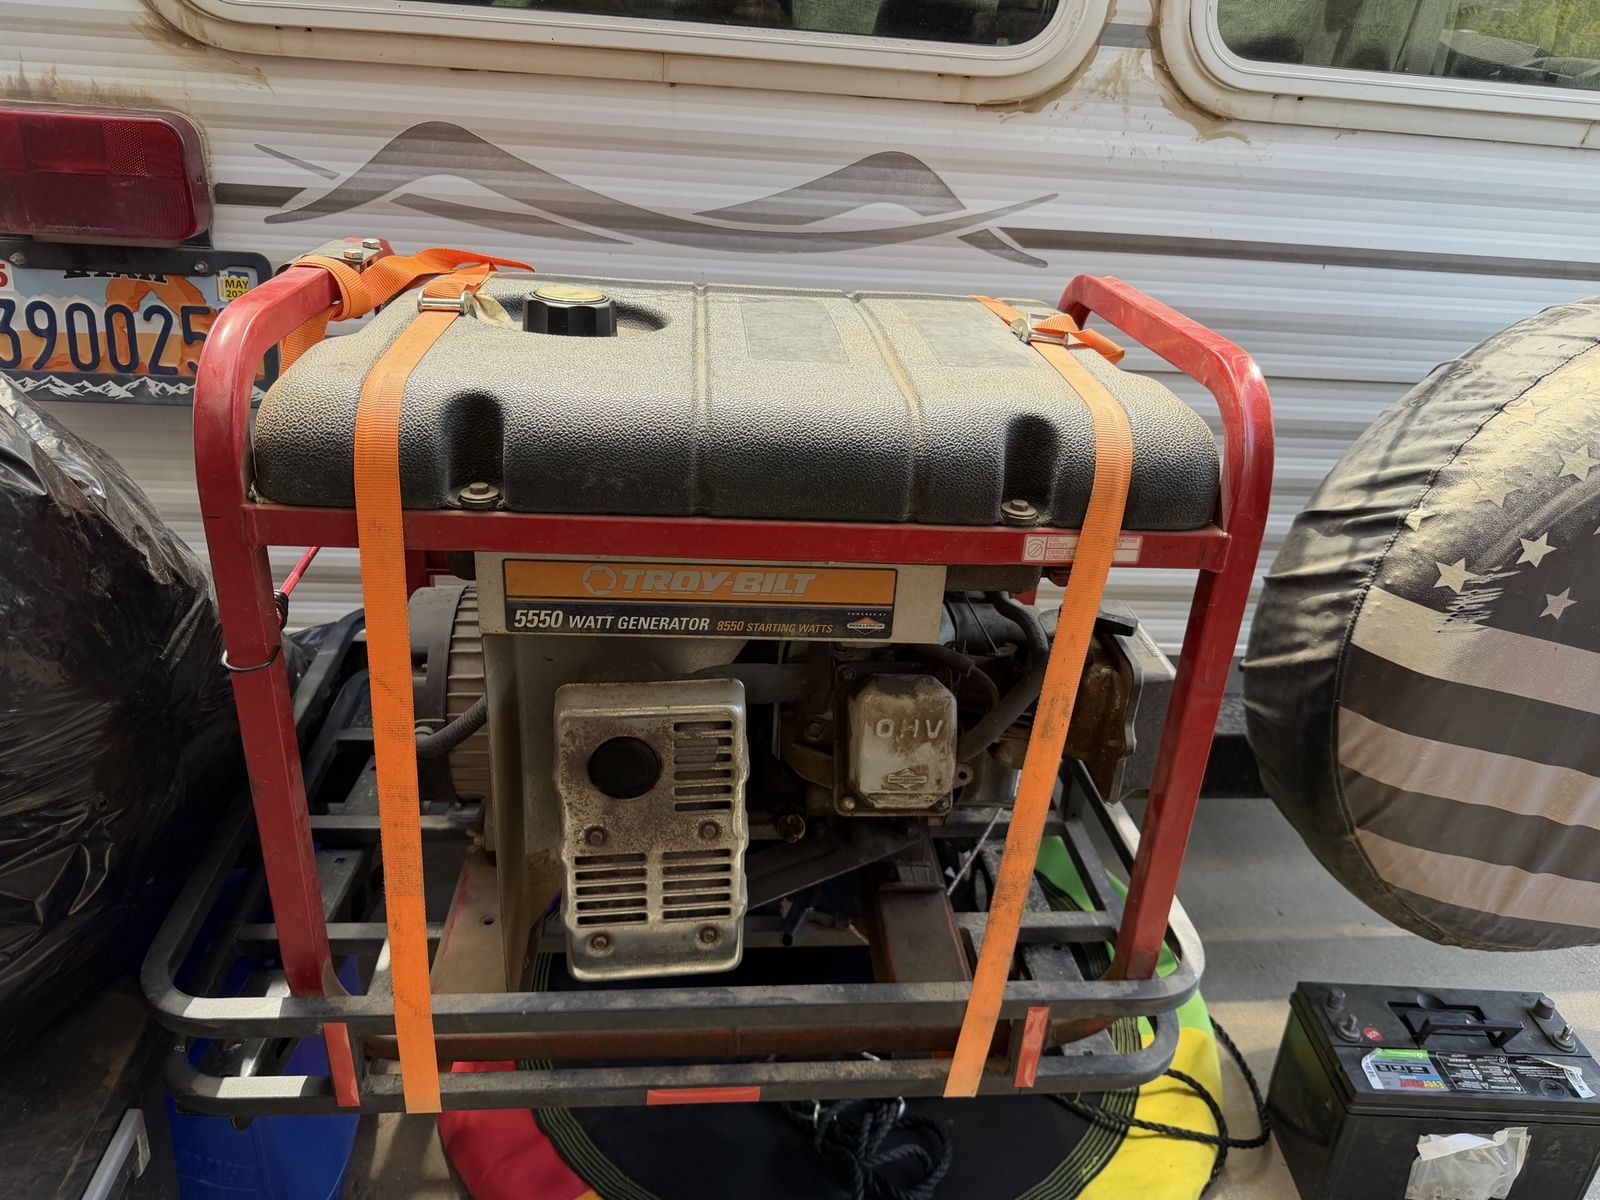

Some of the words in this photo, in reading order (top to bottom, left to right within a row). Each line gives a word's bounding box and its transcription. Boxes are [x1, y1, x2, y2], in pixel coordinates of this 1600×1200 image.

[225, 279, 249, 289] MAY
[620, 568, 817, 597] TROY-BILT
[514, 609, 564, 628] 5550
[569, 615, 615, 629] WATT
[617, 616, 710, 631] GENERATOR
[716, 620, 745, 632] 8550
[746, 623, 796, 633] STARTING
[798, 624, 833, 633] WATTS
[876, 719, 943, 739] OHV
